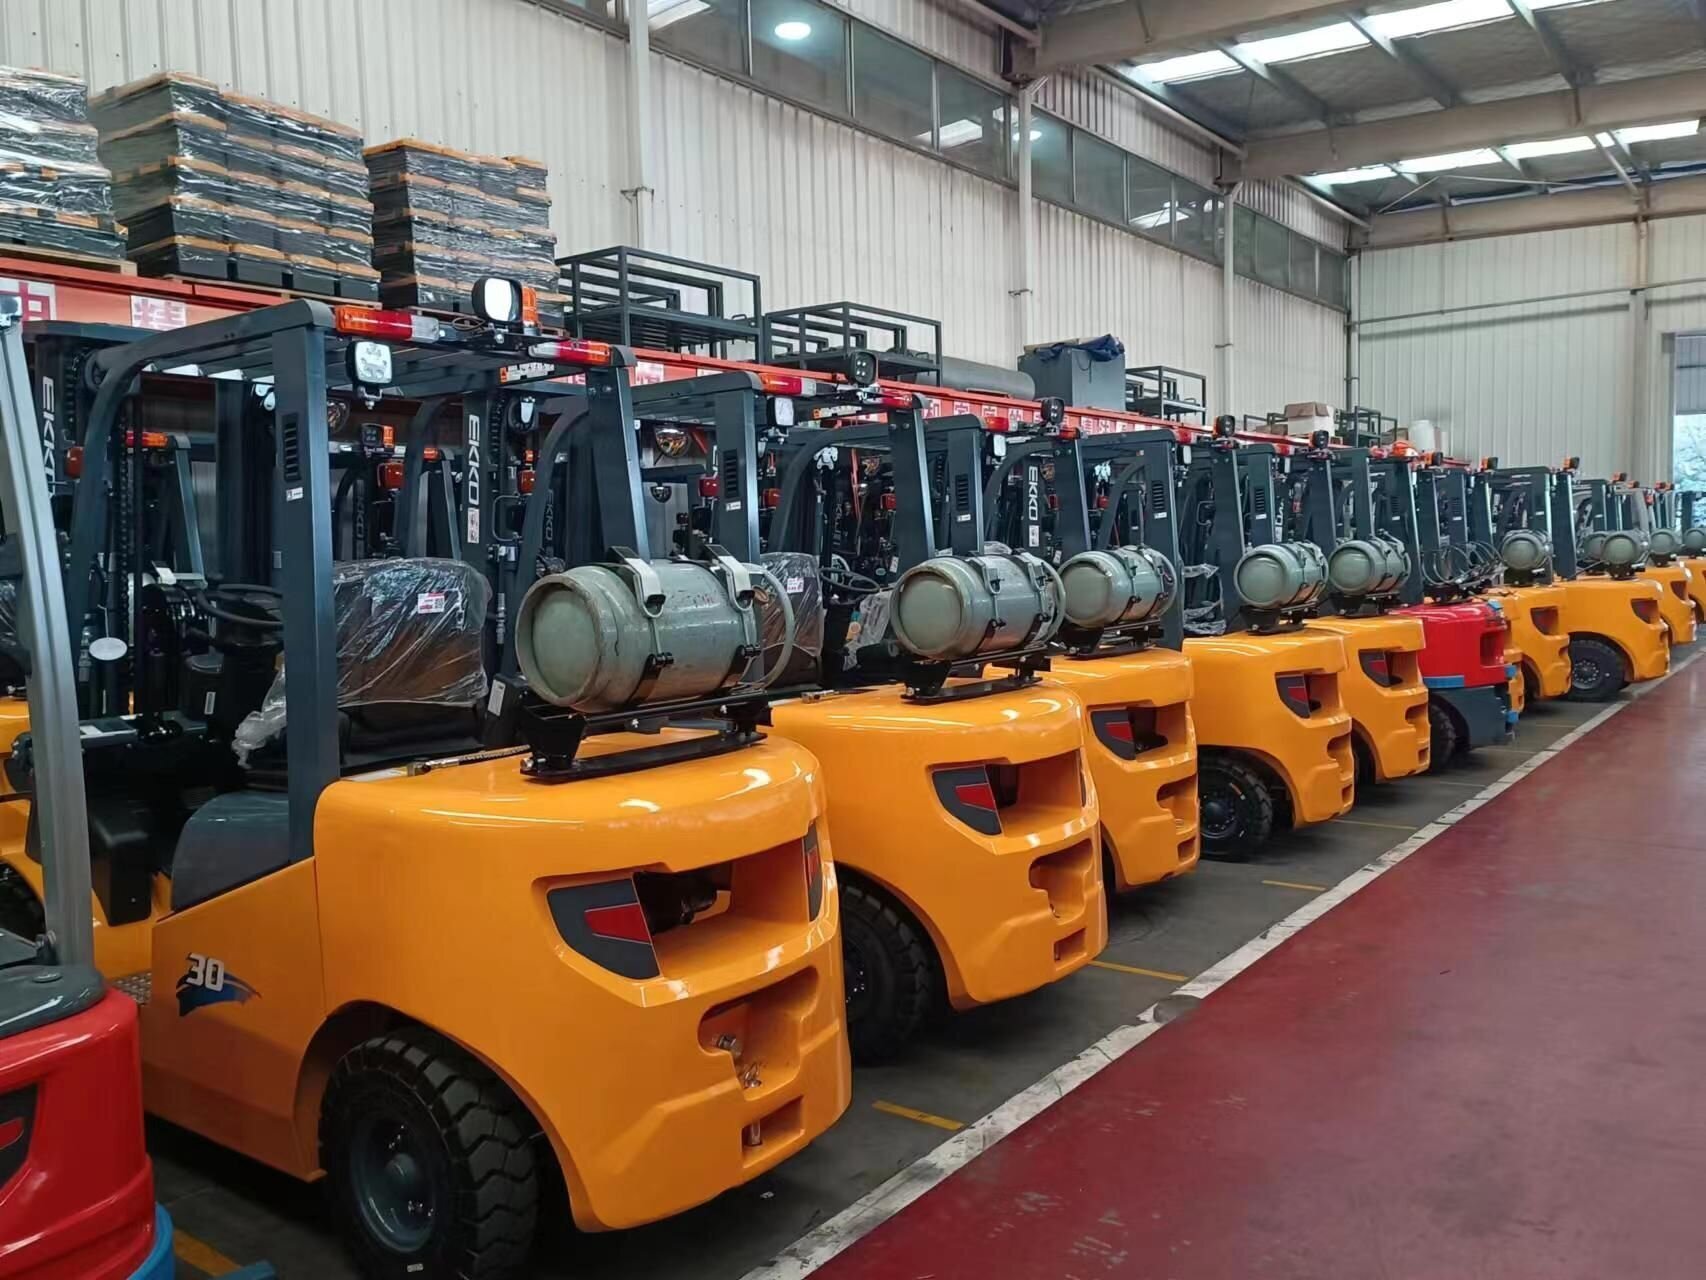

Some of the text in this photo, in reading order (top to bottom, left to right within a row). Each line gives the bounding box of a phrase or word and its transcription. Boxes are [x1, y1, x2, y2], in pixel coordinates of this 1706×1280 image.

[468, 414, 480, 505] EKKO
[1028, 465, 1038, 520] EKKO
[186, 952, 225, 992] 30
